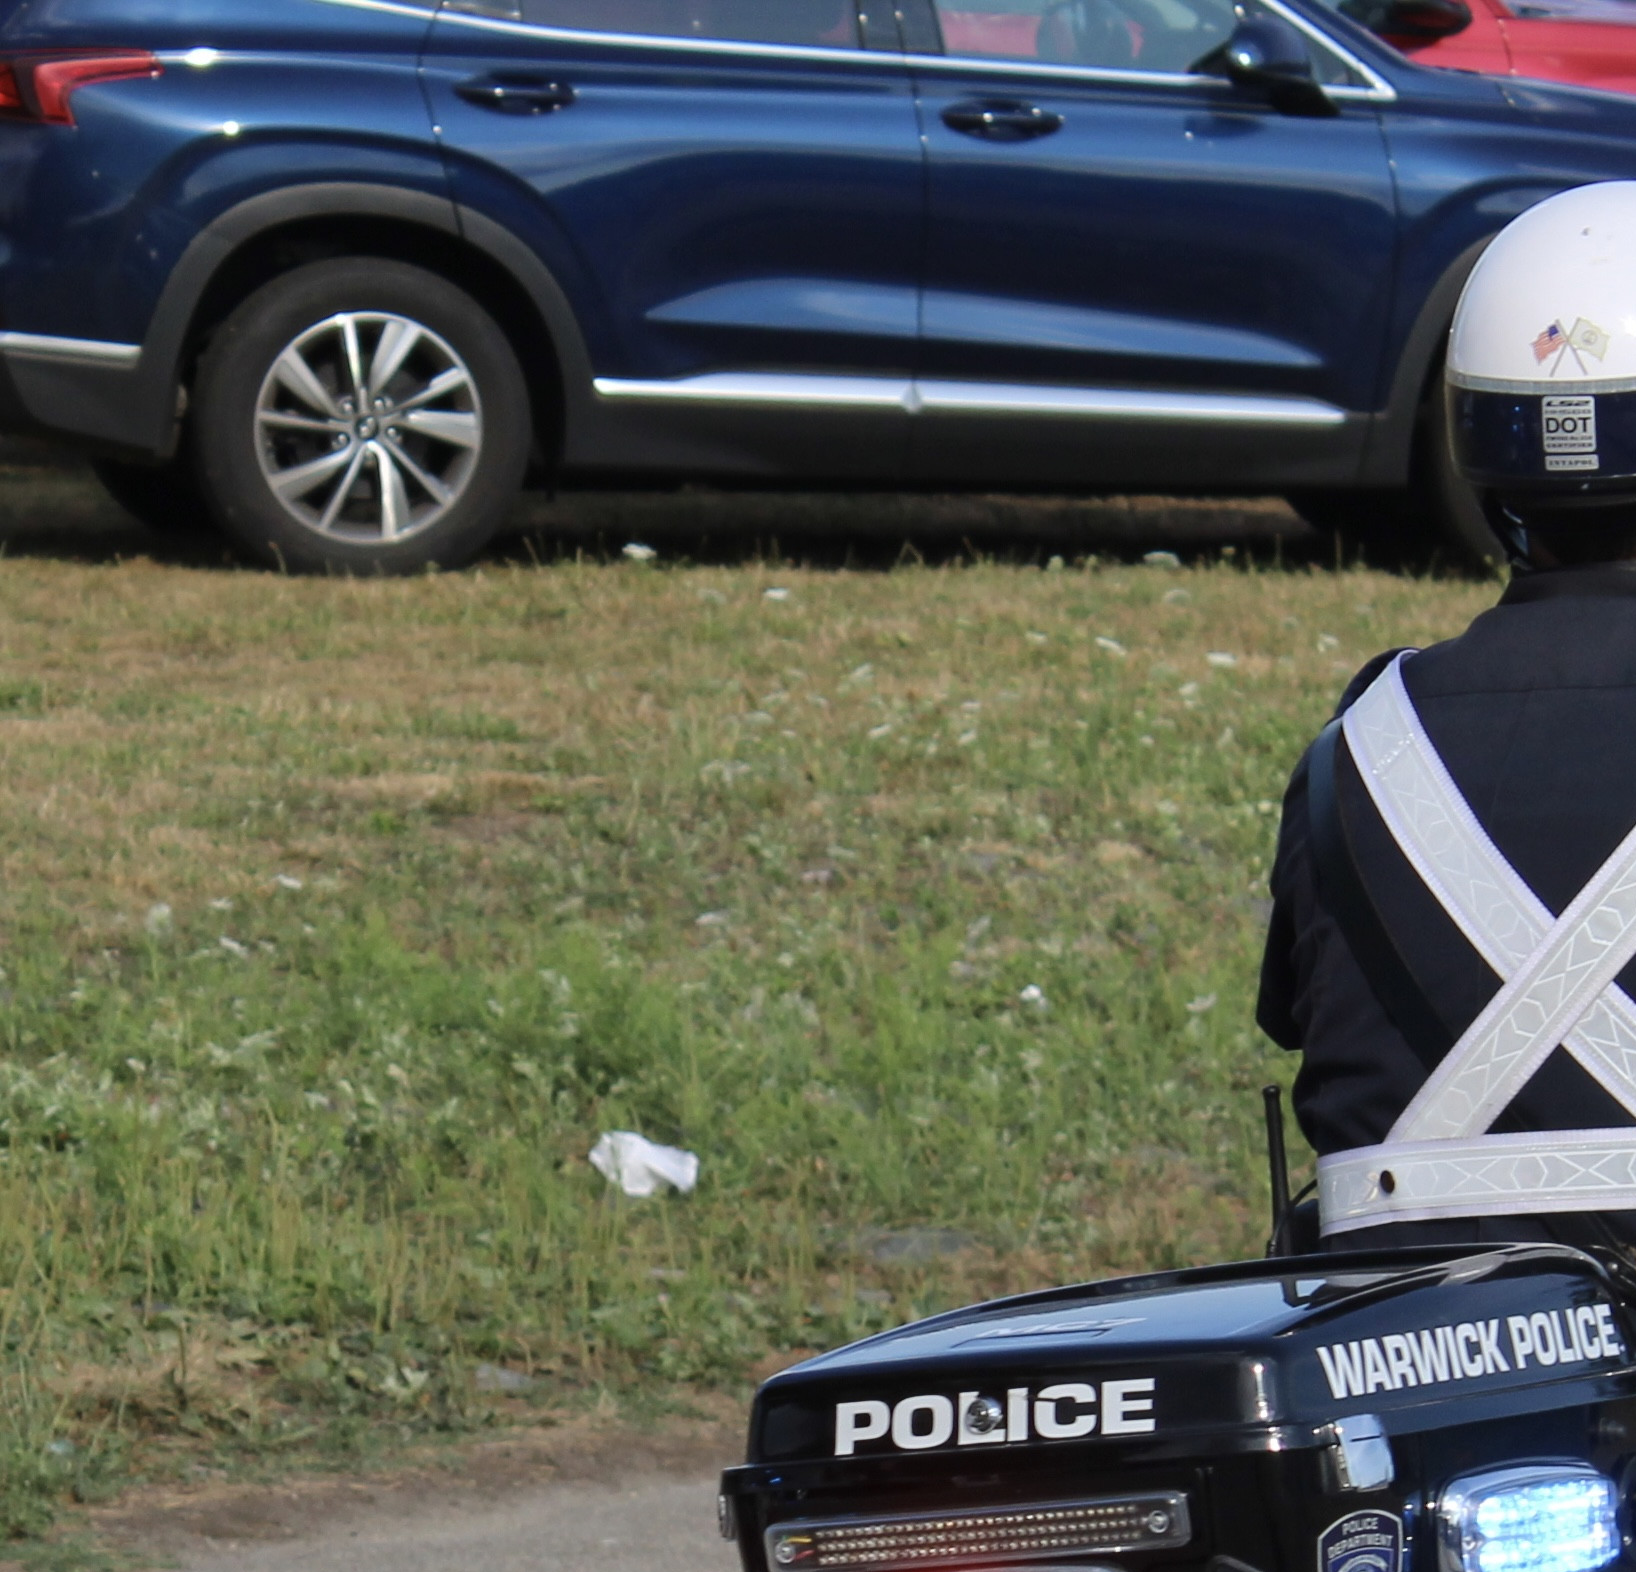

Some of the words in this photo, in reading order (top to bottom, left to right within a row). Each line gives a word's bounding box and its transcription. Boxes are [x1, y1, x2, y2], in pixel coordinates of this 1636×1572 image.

[1546, 417, 1592, 433] DOT
[1316, 1318, 1510, 1400] WARWICK
[834, 1377, 1156, 1456] POLICE
[1342, 1518, 1378, 1535] POLICE
[1327, 1533, 1394, 1559] DEPARTMENT
